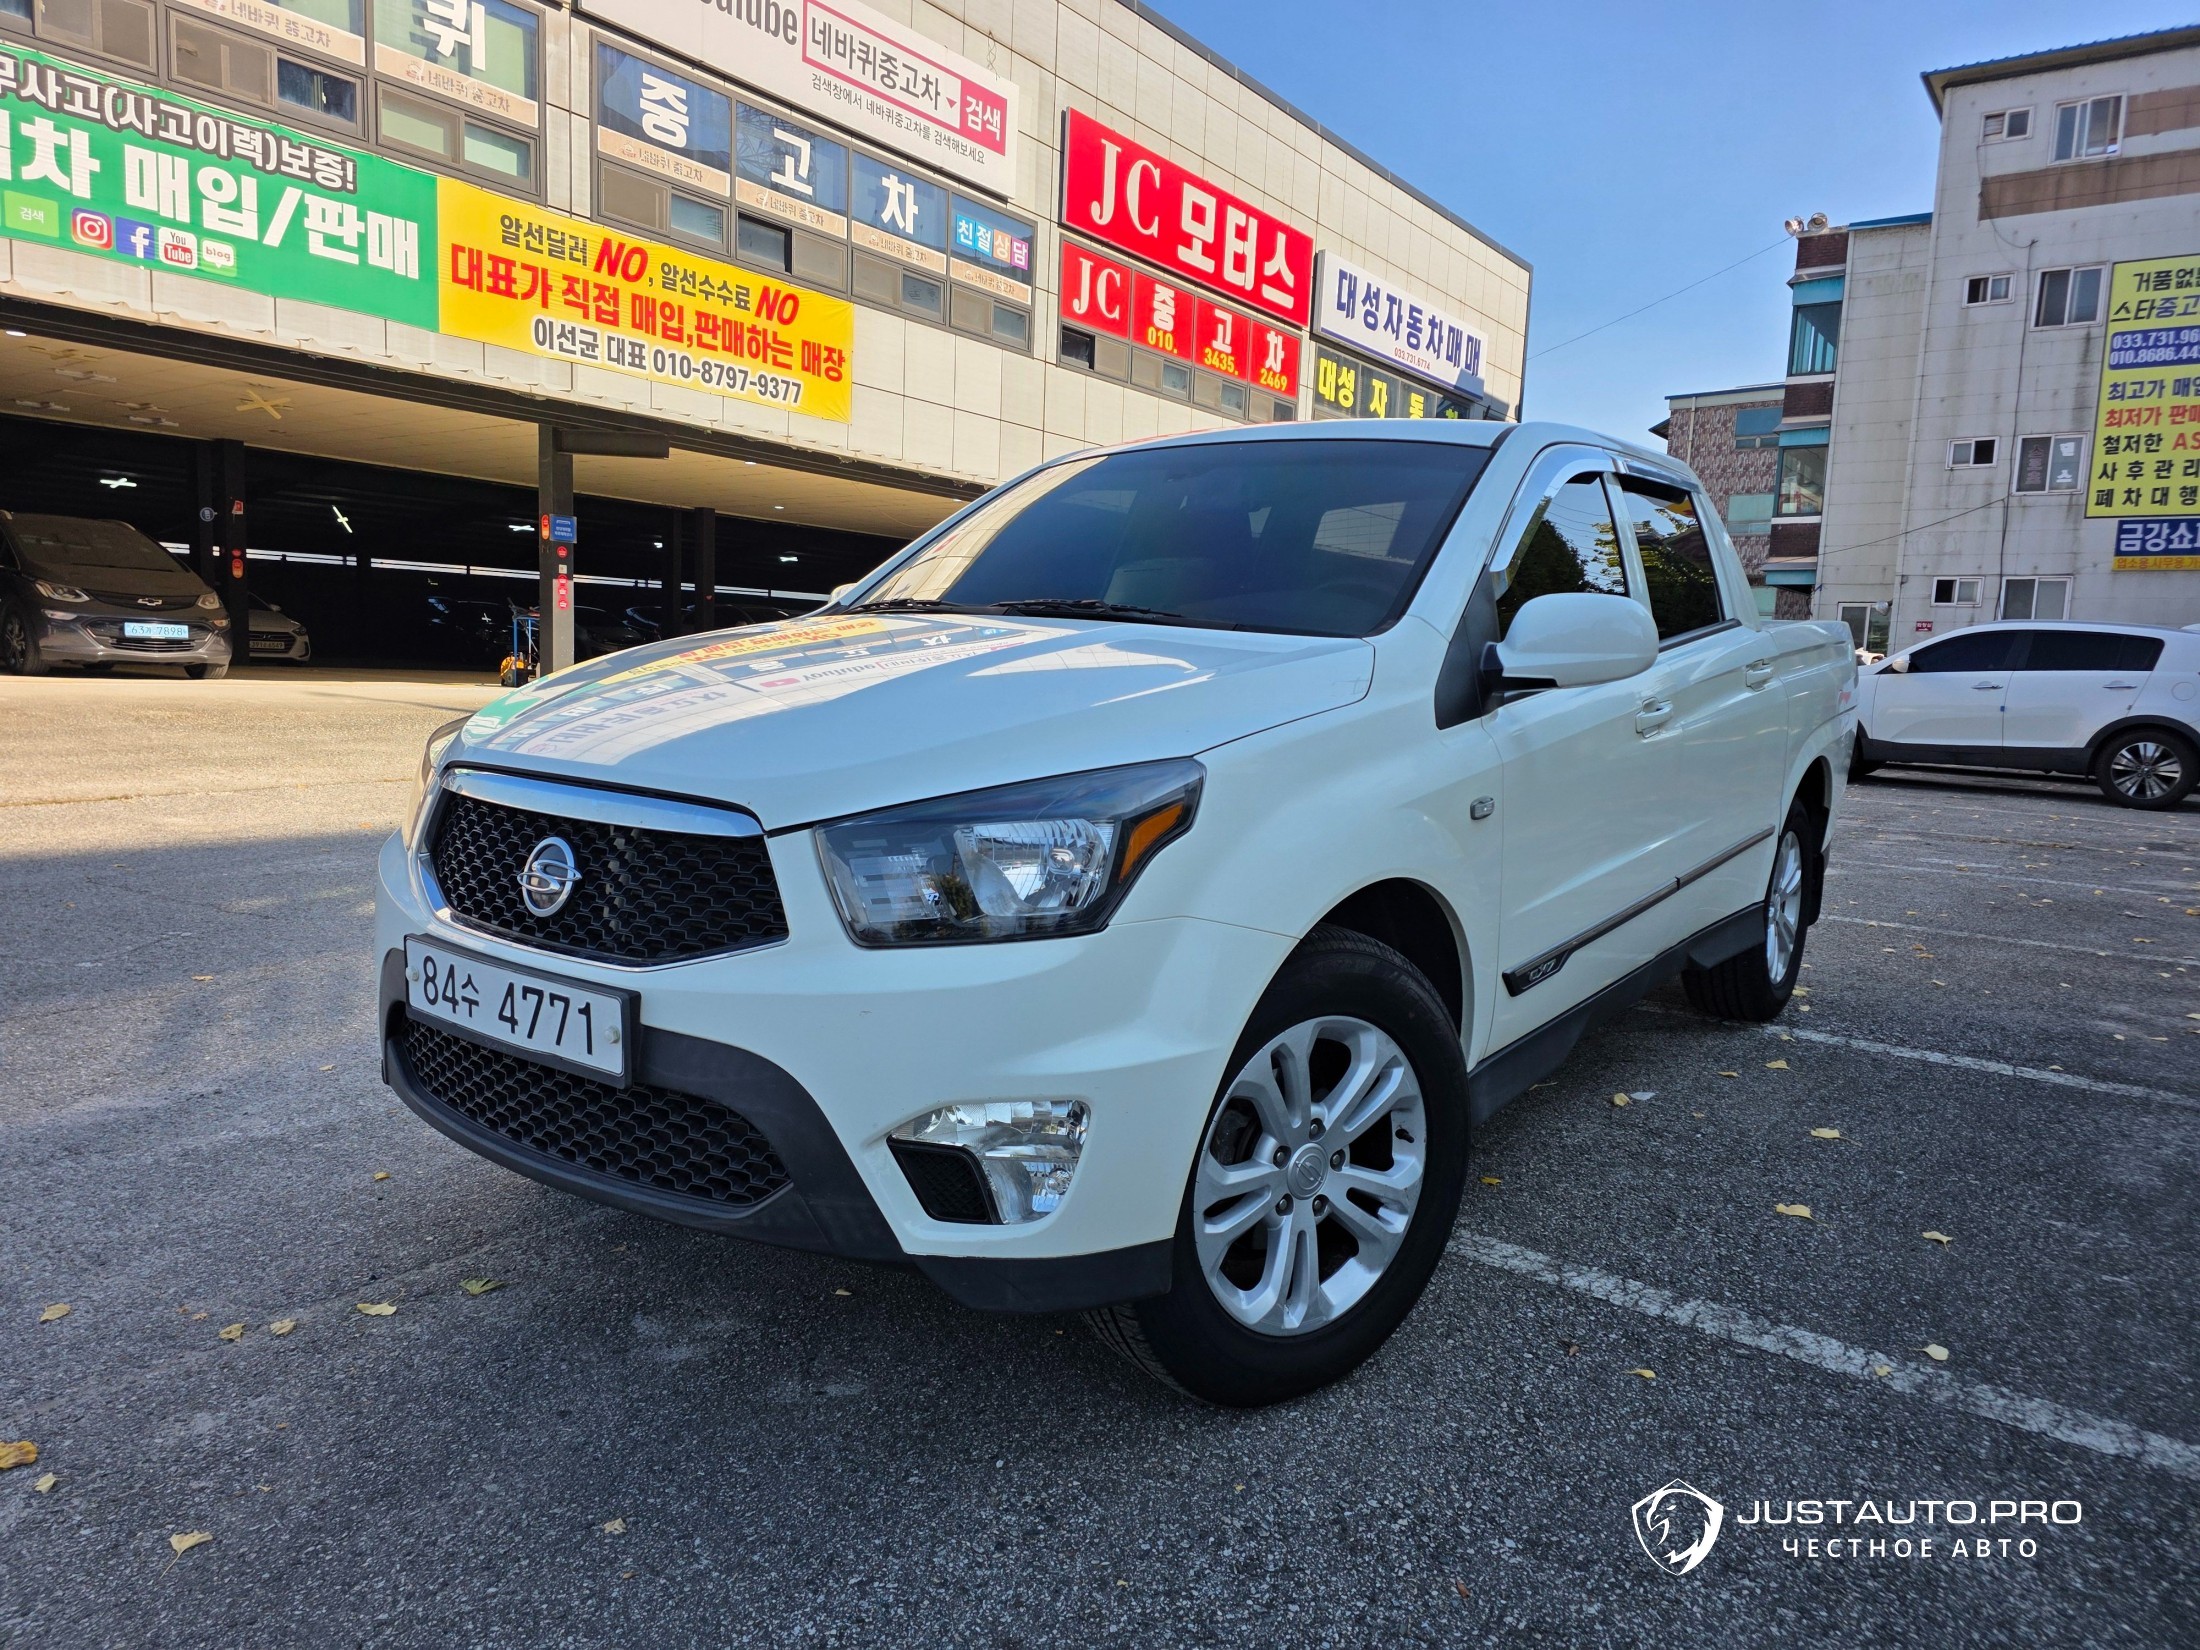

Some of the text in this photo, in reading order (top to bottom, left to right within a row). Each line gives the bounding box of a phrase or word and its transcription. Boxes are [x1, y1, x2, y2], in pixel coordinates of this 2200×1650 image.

[702, 0, 798, 46] ube
[811, 17, 1001, 142] 네바퀴중고차 검색
[811, 73, 986, 165] 검색창에서 네바퀴중고차를 검색해보세요
[0, 109, 420, 280] 차 매입/판매
[20, 207, 44, 224] 검색
[170, 231, 187, 246] You
[958, 219, 1027, 266] 친절상담
[1091, 138, 1296, 310] JC 모터스
[165, 245, 192, 264] Tube
[206, 245, 231, 262] blog
[500, 214, 588, 267] 알선딜러
[660, 261, 751, 312] 알선수수료
[755, 285, 801, 326] NO
[1071, 257, 1122, 321] JC
[2133, 267, 2200, 292] 거품없
[450, 242, 847, 383] 대표가 직접 매입,판매하는 매장
[1336, 267, 1482, 378] 대성자동차매매
[534, 318, 802, 404] 이선균 대표 010-8797-9377
[2109, 344, 2200, 365] 010.8686.44
[1260, 368, 1288, 392] 2469
[1318, 357, 1356, 409] 대성
[2107, 379, 2166, 401] 최고가
[2104, 406, 2163, 428] 최저가
[2103, 432, 2164, 455] 철저한
[2120, 522, 2200, 552] 금강쇼
[156, 626, 183, 636] 7898
[423, 955, 593, 1056] 84수 4771
